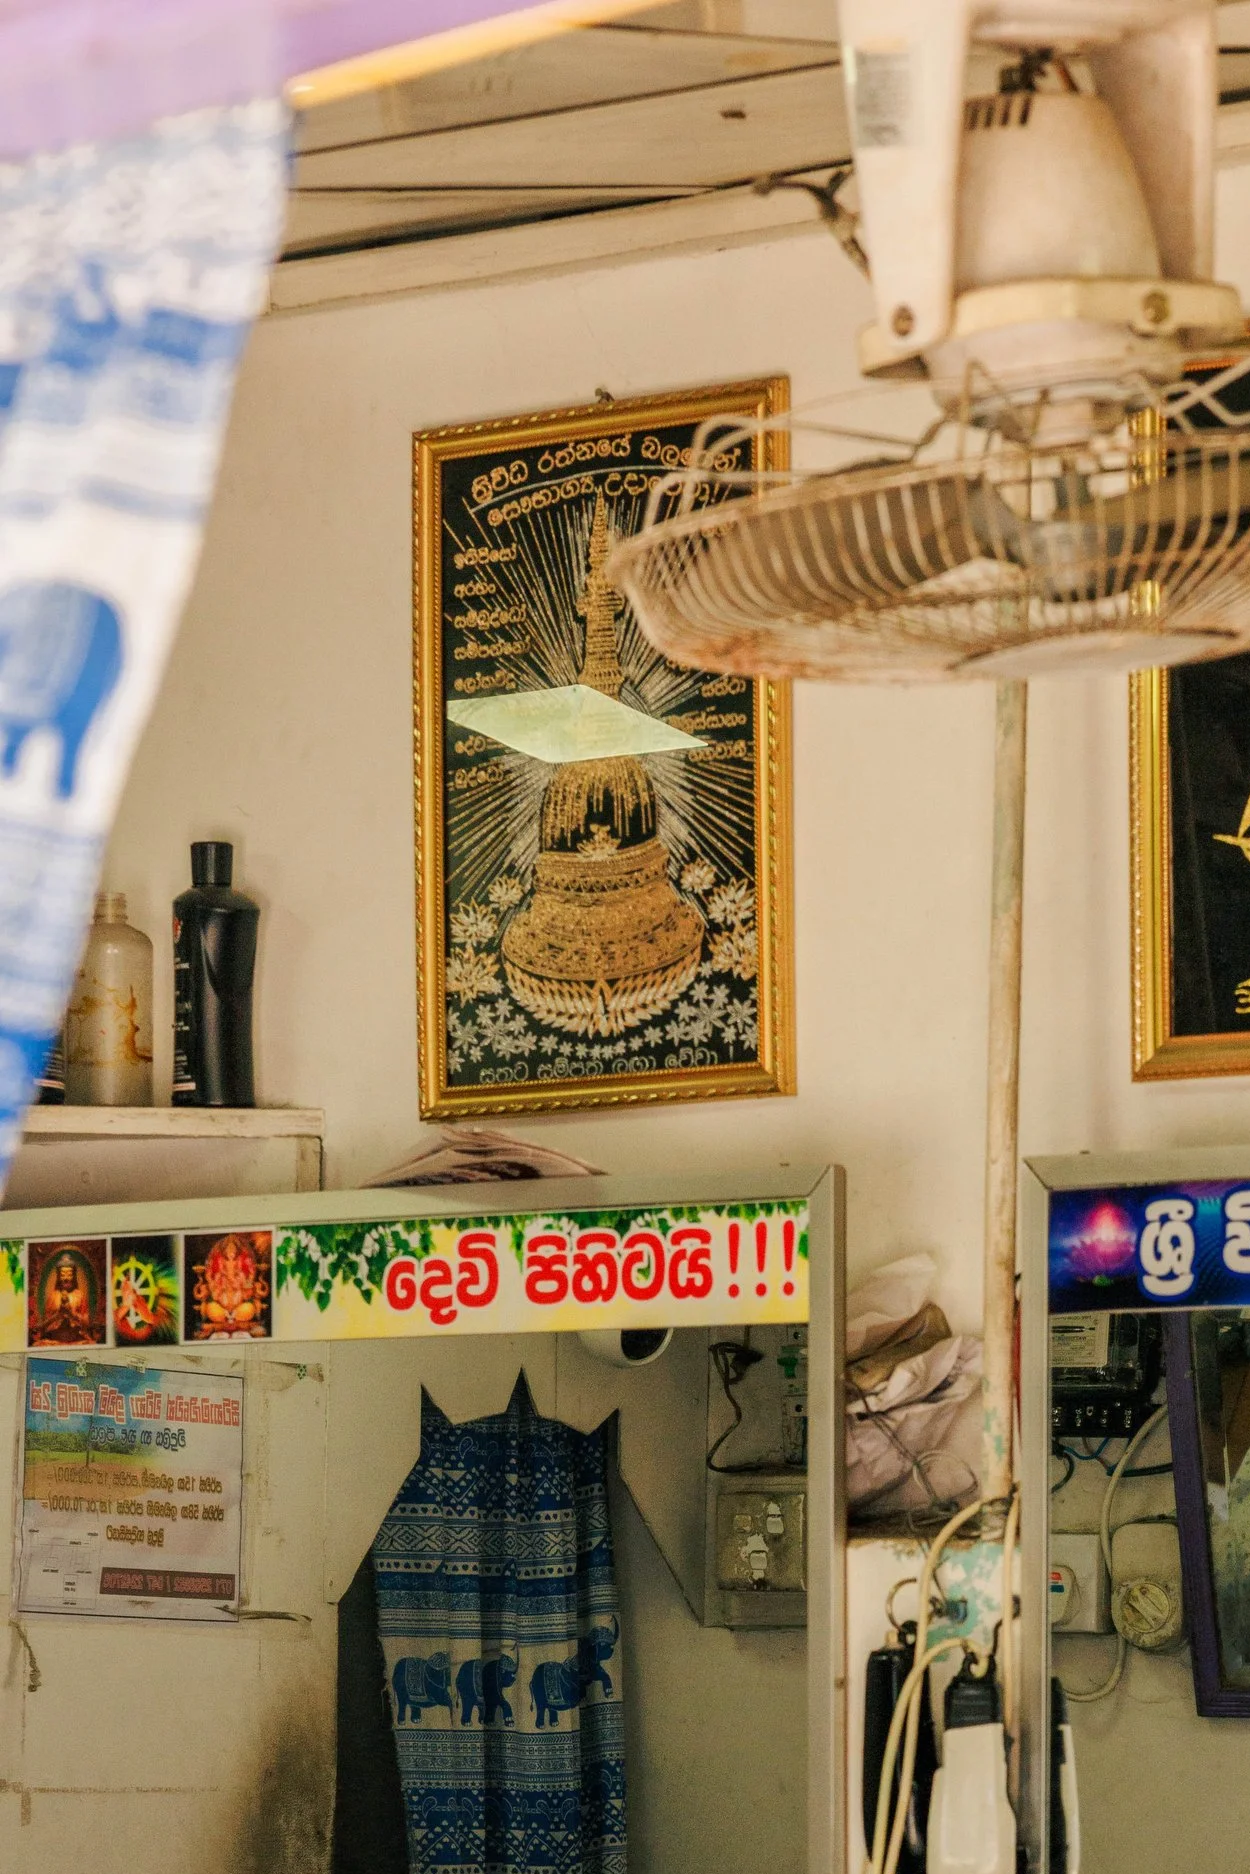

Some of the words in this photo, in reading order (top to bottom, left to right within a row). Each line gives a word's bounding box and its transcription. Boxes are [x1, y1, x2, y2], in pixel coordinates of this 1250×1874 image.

[538, 433, 631, 474] රත්නයේ
[384, 1231, 499, 1326] දෙවි
[1140, 1198, 1195, 1296] ශ්‍රී
